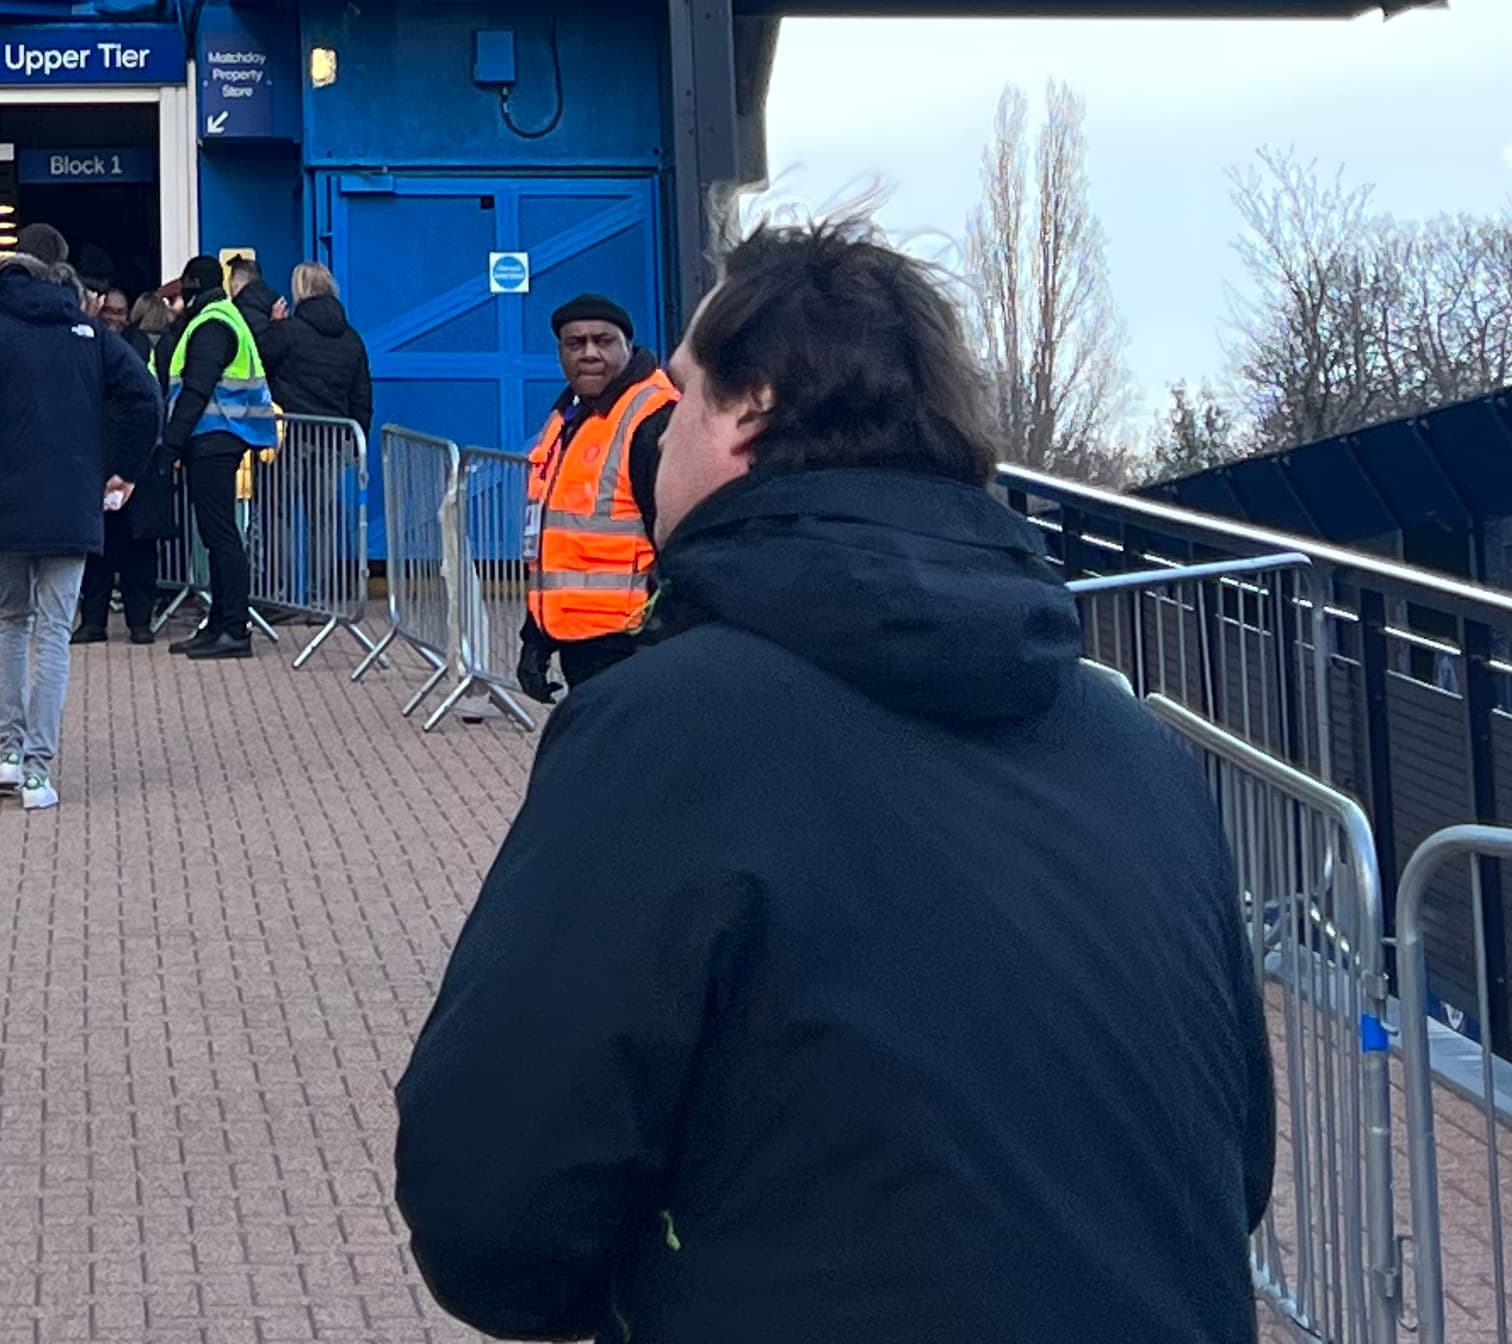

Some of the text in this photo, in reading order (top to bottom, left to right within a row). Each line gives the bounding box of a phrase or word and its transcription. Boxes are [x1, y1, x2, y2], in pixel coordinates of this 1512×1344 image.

[4, 42, 151, 76] Upper Tier
[207, 51, 266, 65] Matchday
[211, 67, 264, 83] Property
[221, 84, 254, 98] Store
[50, 154, 123, 175] Block 1
